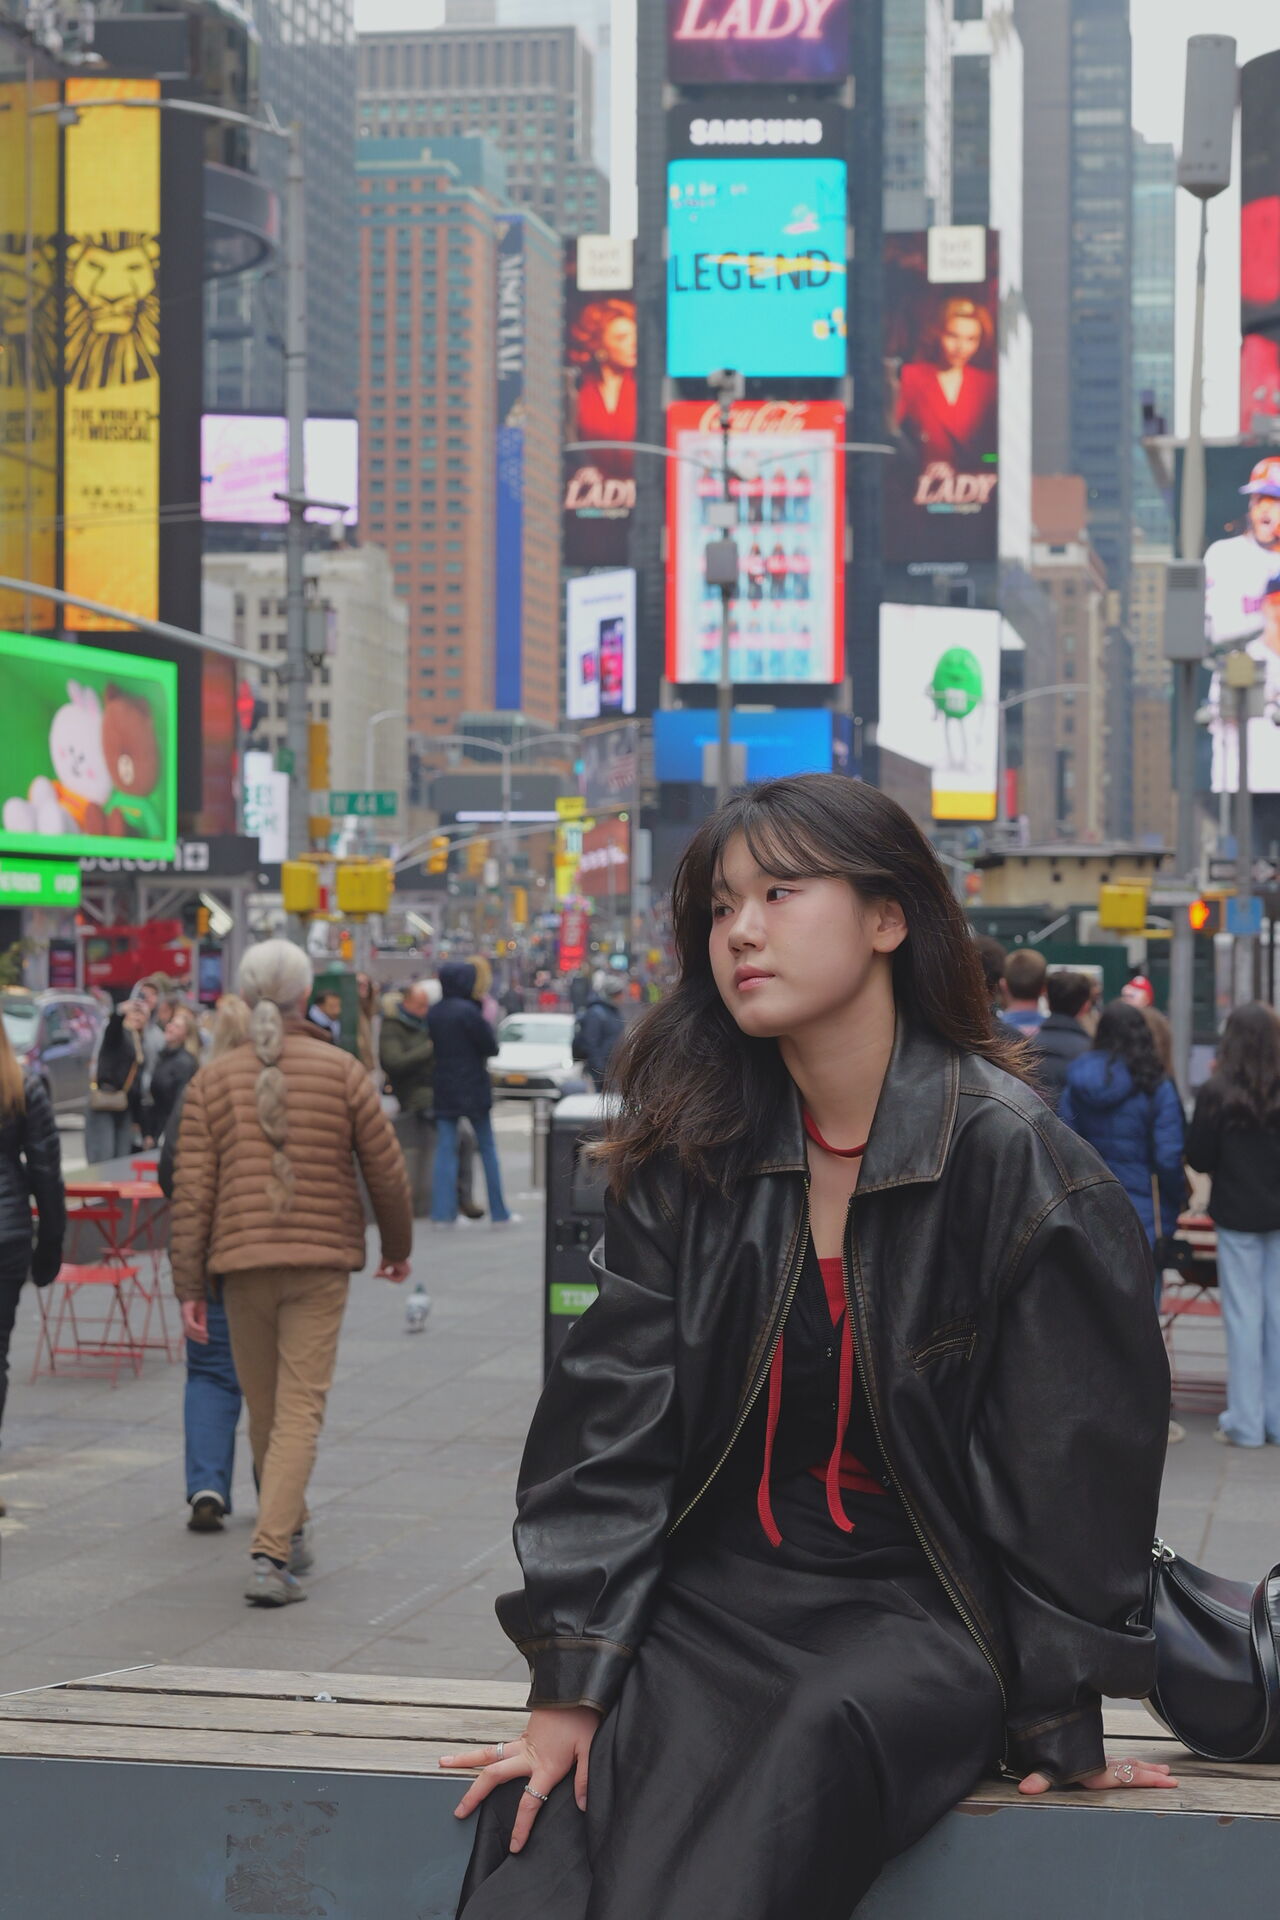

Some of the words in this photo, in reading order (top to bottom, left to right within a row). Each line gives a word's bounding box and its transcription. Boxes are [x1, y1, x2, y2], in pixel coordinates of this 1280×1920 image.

[674, 0, 836, 40] LADY
[689, 118, 823, 145] SAMSUNG
[674, 250, 832, 292] LEGEND
[913, 473, 998, 505] LADY
